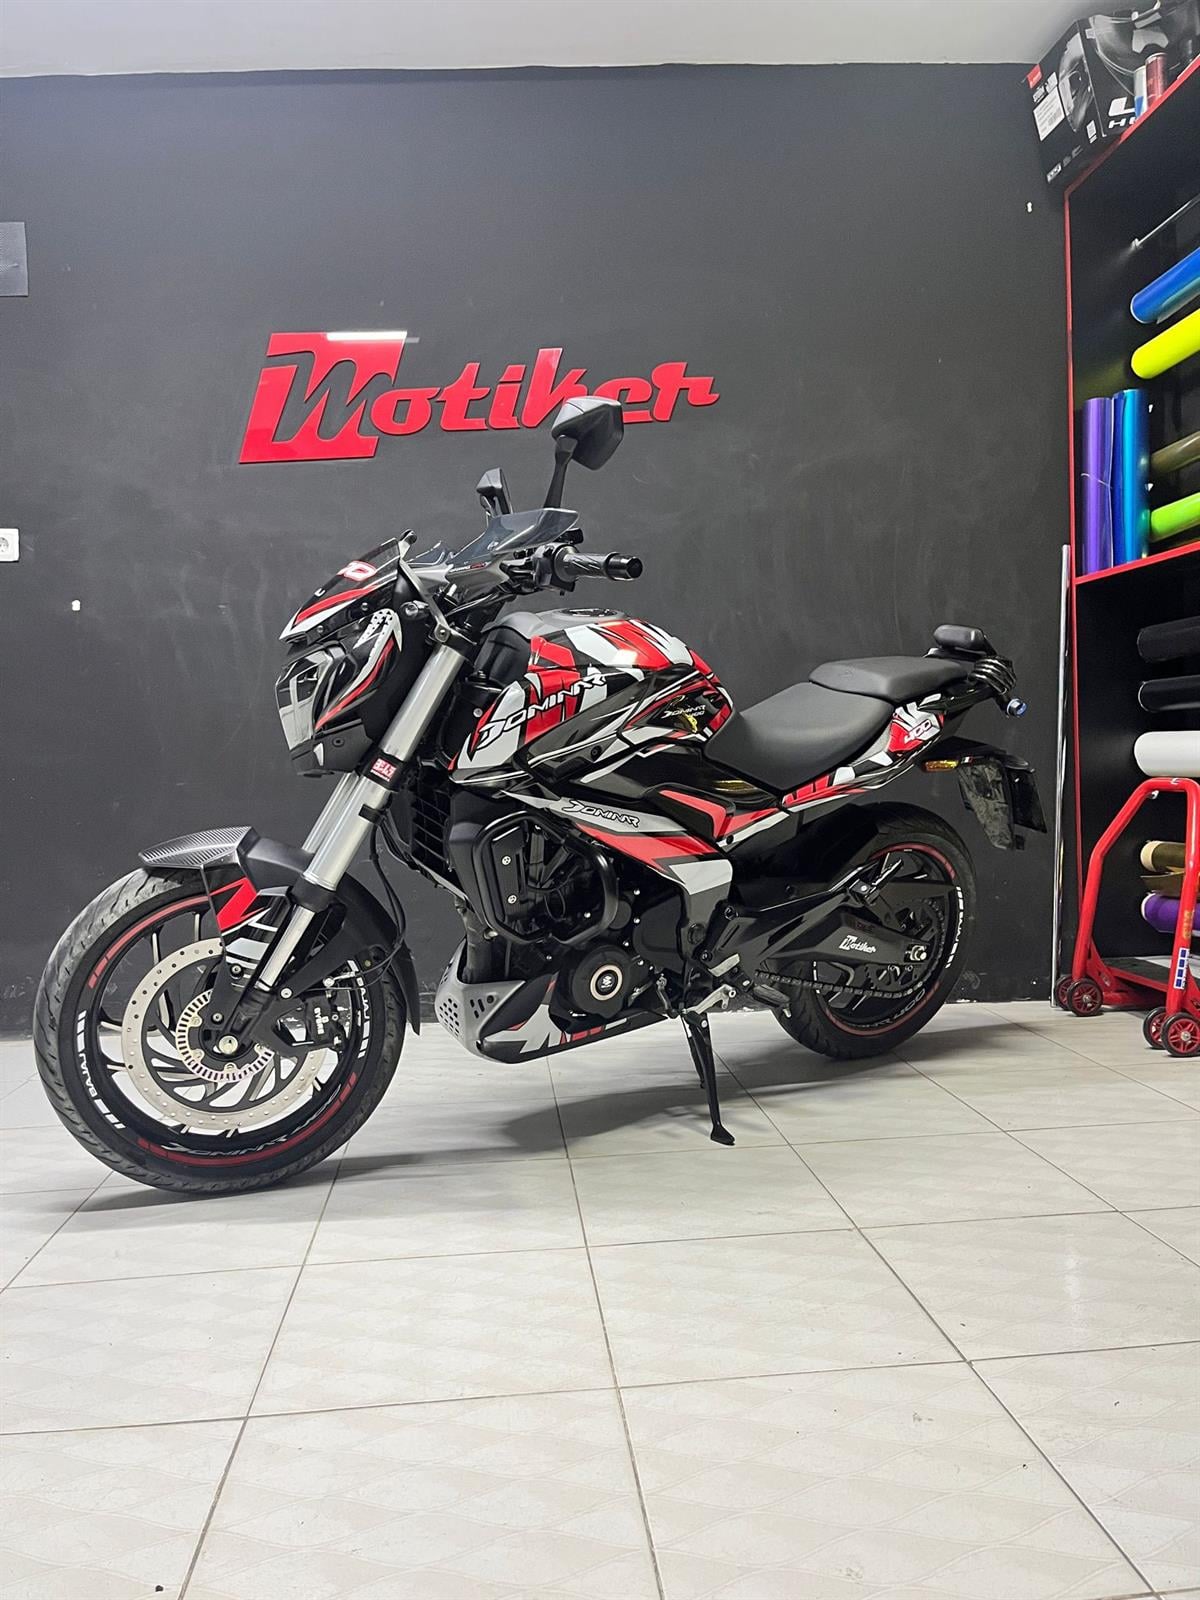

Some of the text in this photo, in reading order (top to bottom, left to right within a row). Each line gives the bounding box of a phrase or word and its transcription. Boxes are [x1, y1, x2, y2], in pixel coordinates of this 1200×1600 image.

[239, 330, 720, 464] Motiker
[476, 674, 607, 751] DOMINAR
[562, 799, 640, 828] DOMINAR
